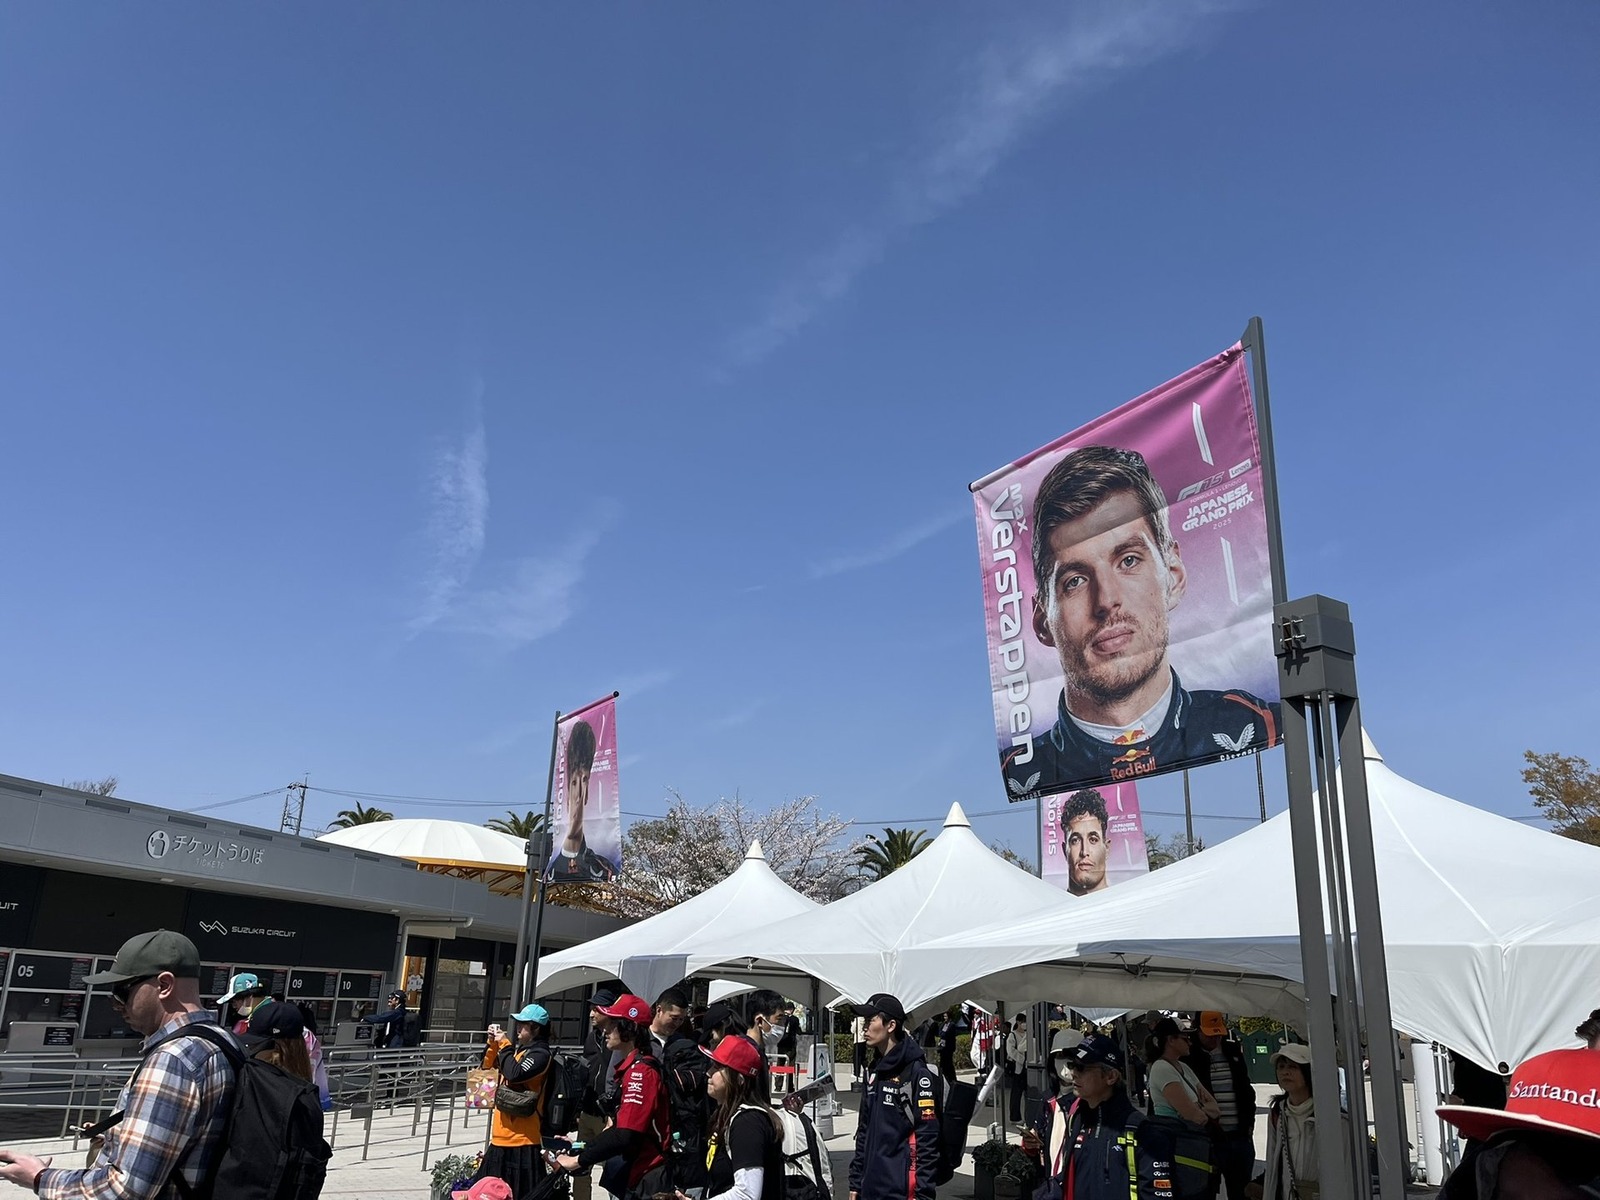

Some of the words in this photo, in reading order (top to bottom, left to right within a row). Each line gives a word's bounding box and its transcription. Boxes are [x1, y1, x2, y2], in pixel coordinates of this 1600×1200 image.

[1231, 462, 1250, 476] Lenovo
[1010, 482, 1028, 535] Max
[1182, 506, 1228, 531] GRAND
[1227, 491, 1255, 514] PRIX
[1186, 483, 1249, 519] JAPANESE
[1213, 517, 1232, 530] 2025
[990, 487, 1035, 766] Verstappen
[1110, 763, 1134, 781] Red
[1134, 757, 1157, 775] Bull
[1047, 794, 1059, 857] Norris
[172, 835, 265, 865] チケットうりば
[231, 925, 265, 936] SUZUKA
[266, 929, 297, 938] CIRCUIT
[17, 965, 35, 978] 05
[292, 979, 303, 989] 09
[343, 981, 352, 990] 10
[1509, 1080, 1600, 1108] Santand
